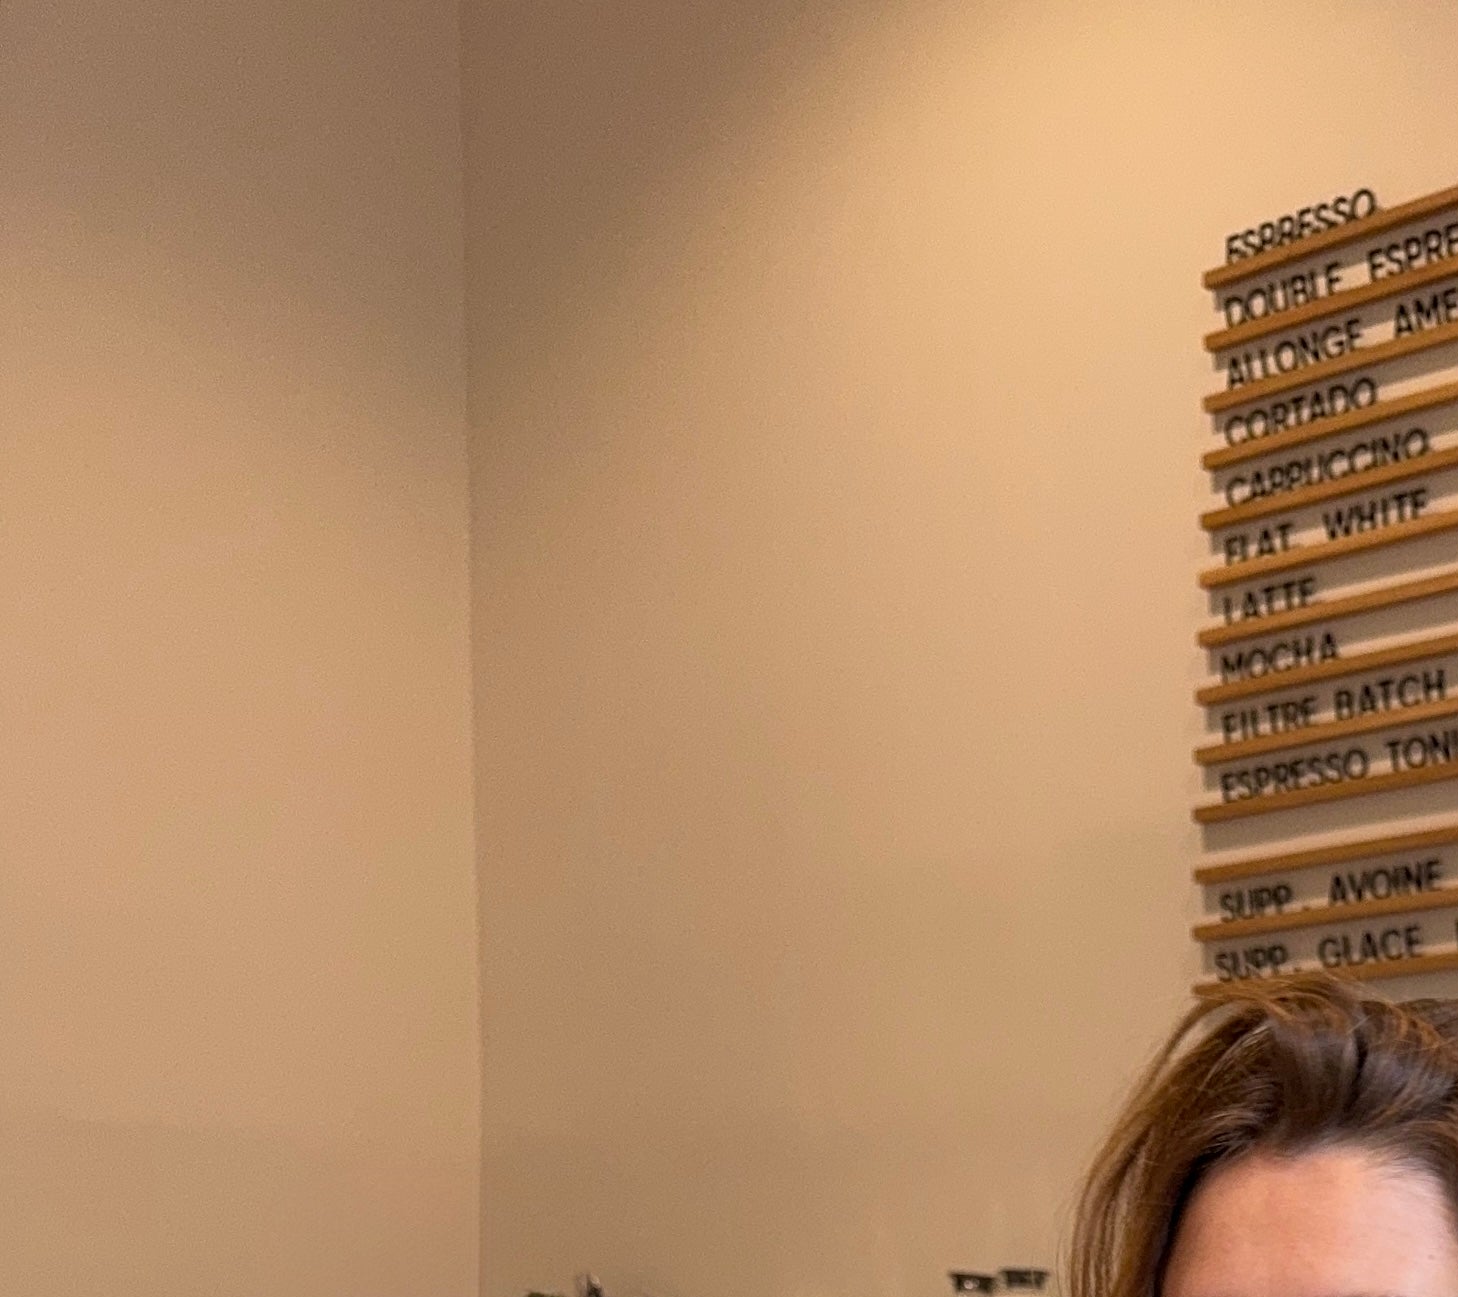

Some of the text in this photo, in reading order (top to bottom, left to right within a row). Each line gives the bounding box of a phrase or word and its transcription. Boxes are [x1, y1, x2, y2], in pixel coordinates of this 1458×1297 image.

[1224, 189, 1378, 263] ESPRESSO
[1223, 260, 1345, 330] DOUBLE
[1223, 377, 1378, 449] CORTADO
[1224, 427, 1432, 508] CAPPUCCINO
[1223, 522, 1295, 568] FLAT
[1322, 495, 1428, 542] WHITE
[1222, 578, 1317, 625] LATTE
[1219, 631, 1341, 687] MOCHA
[1220, 696, 1317, 745] FILTRE
[1334, 668, 1448, 720] BATCH
[1219, 748, 1369, 804] ESPRESSO
[1327, 855, 1444, 908] AVOINE
[1317, 924, 1424, 968] GLACE
